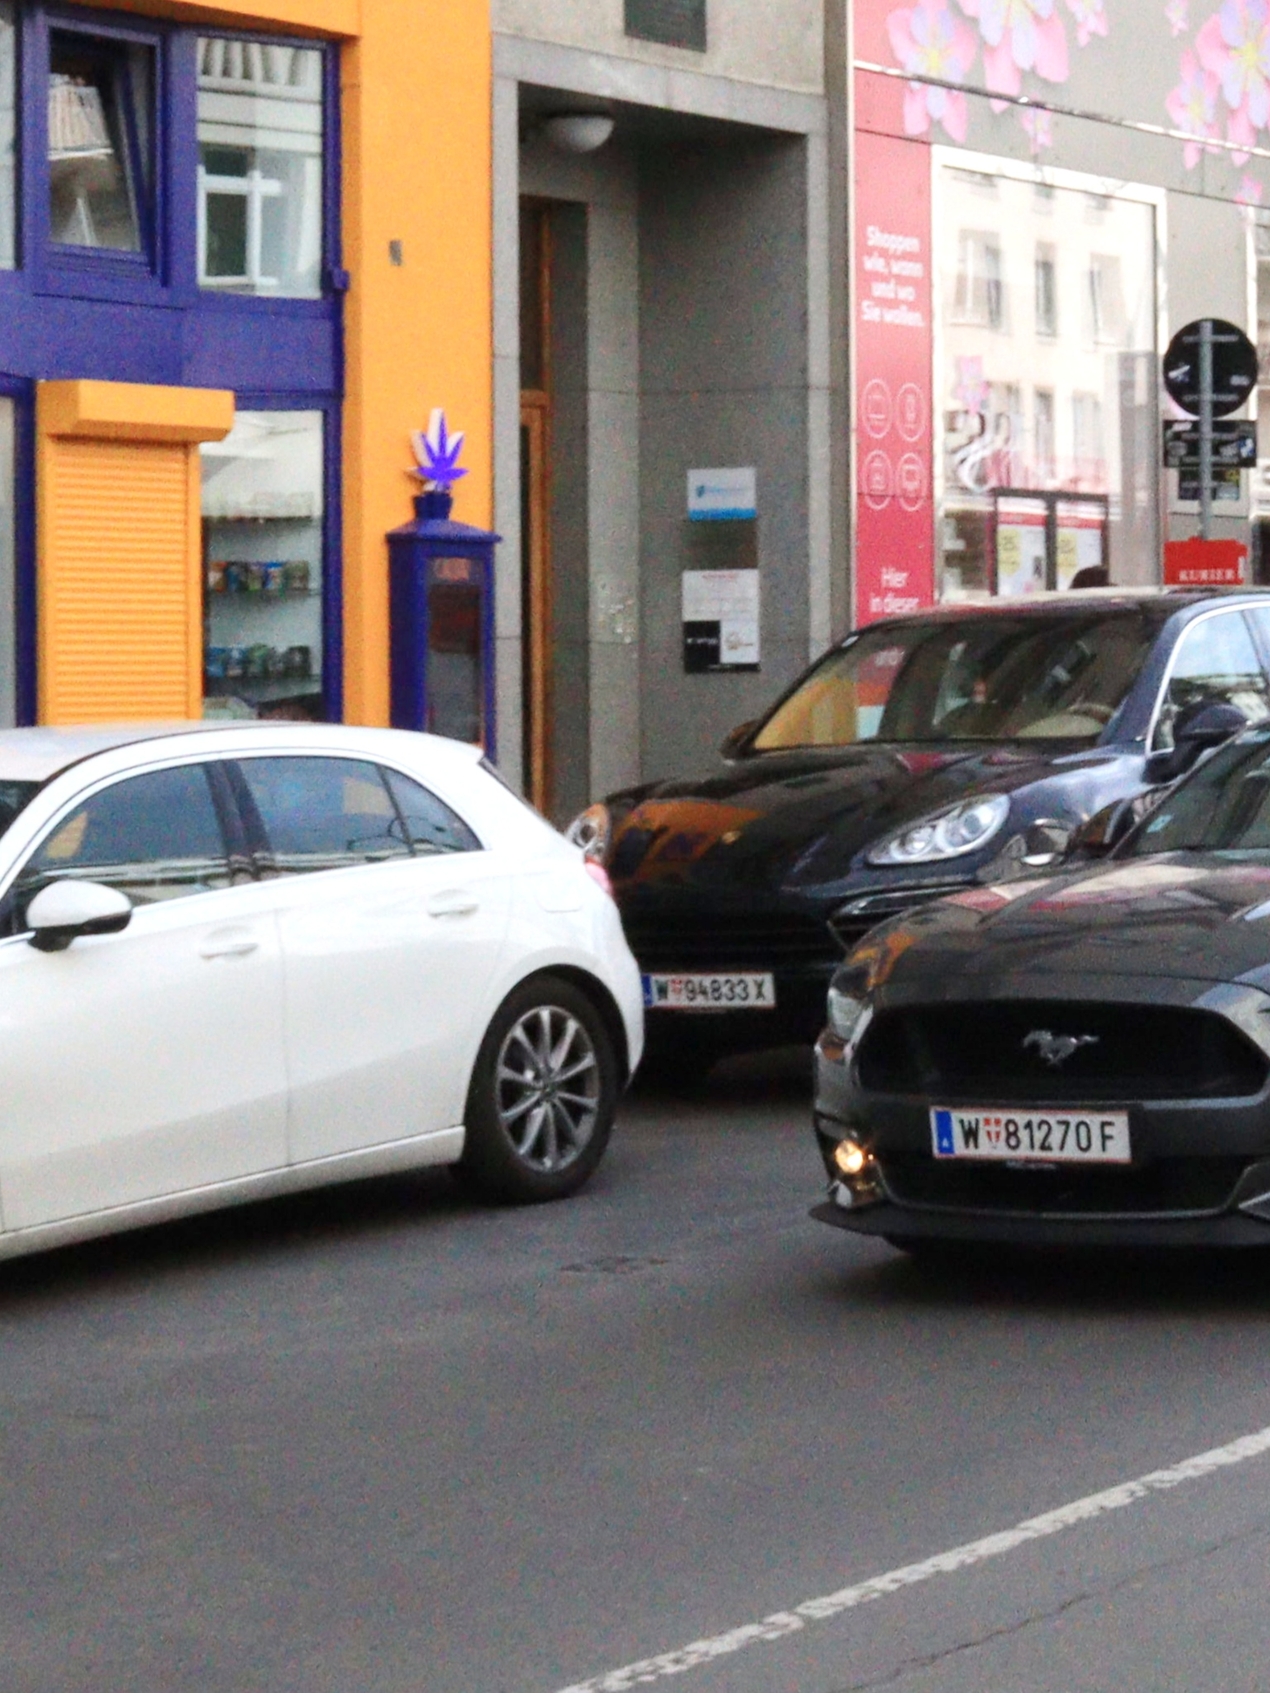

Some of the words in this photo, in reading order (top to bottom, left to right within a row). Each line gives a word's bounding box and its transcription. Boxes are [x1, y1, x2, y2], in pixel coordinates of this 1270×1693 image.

[867, 225, 920, 255] Shoppen
[890, 258, 924, 278] wann
[871, 278, 895, 299] und
[896, 285, 917, 302] wo
[861, 300, 882, 322] Sie
[881, 567, 909, 588] Hier
[656, 979, 668, 1001] W
[684, 979, 749, 1001] 94833
[752, 978, 766, 1000] X
[959, 1117, 980, 1150] W
[1004, 1118, 1093, 1152] 81270
[1100, 1121, 1116, 1152] F
